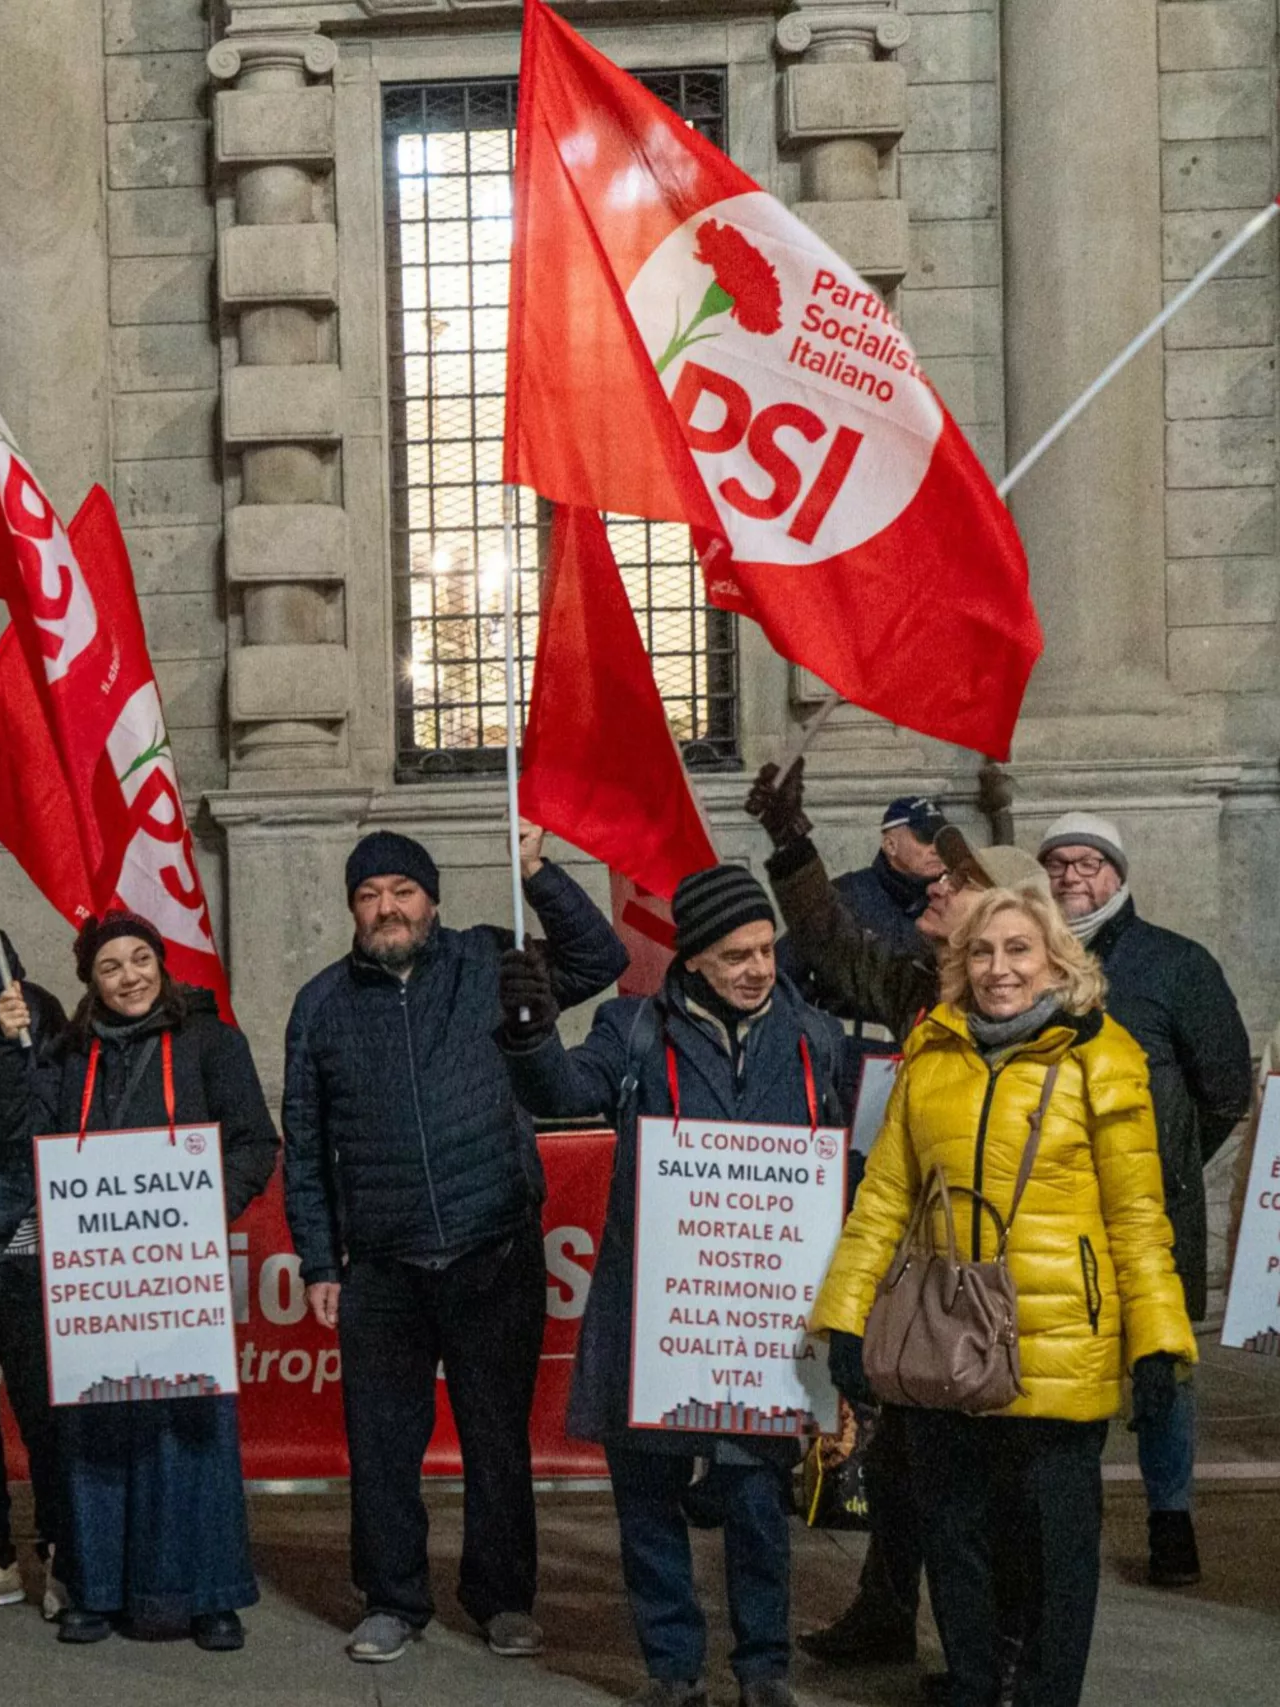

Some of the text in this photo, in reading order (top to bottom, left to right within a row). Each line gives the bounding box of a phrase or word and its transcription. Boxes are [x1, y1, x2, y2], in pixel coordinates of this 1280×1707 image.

[788, 336, 894, 403] Italiano
[669, 361, 864, 545] PSI
[677, 1131, 808, 1154] IL CONDONO
[658, 1159, 826, 1185] SALVA MILANO È
[49, 1170, 213, 1200] NO AL SALVA
[689, 1190, 794, 1212] UN COLPO
[78, 1207, 188, 1234] MILANO.
[678, 1219, 804, 1243] MORTALE AL
[52, 1241, 220, 1270] BASTA CON LA
[698, 1250, 782, 1270] NOSTRO
[50, 1273, 224, 1303] SPECULAZIONE
[665, 1277, 813, 1301] PATRIMONIO E
[55, 1307, 225, 1336] URBANISTICA!!
[669, 1307, 807, 1330] ALLA NOSTRA
[659, 1335, 816, 1360] QUALITÀ DELLA
[711, 1368, 762, 1387] VITA!
